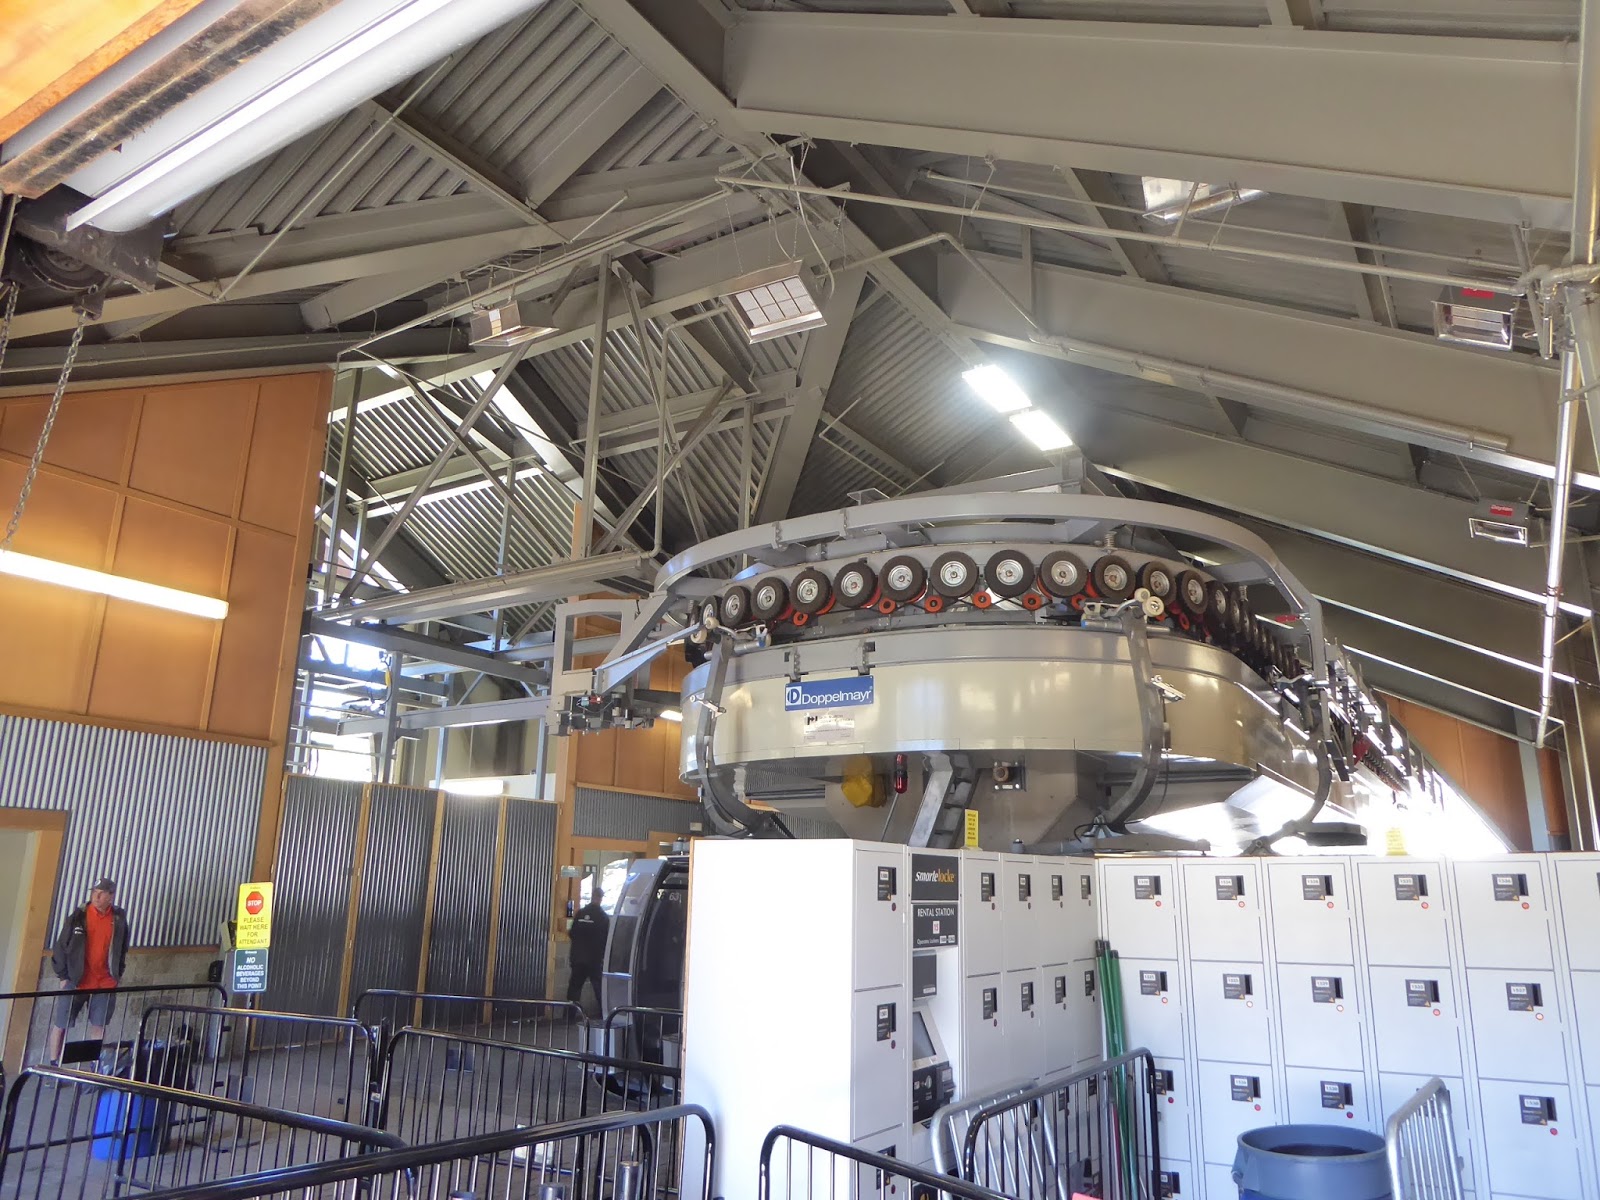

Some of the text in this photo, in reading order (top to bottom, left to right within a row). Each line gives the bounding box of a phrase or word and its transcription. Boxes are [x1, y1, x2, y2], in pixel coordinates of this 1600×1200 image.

[802, 691, 872, 705] Doppelmayr
[917, 907, 954, 917] RENTAL STATION
